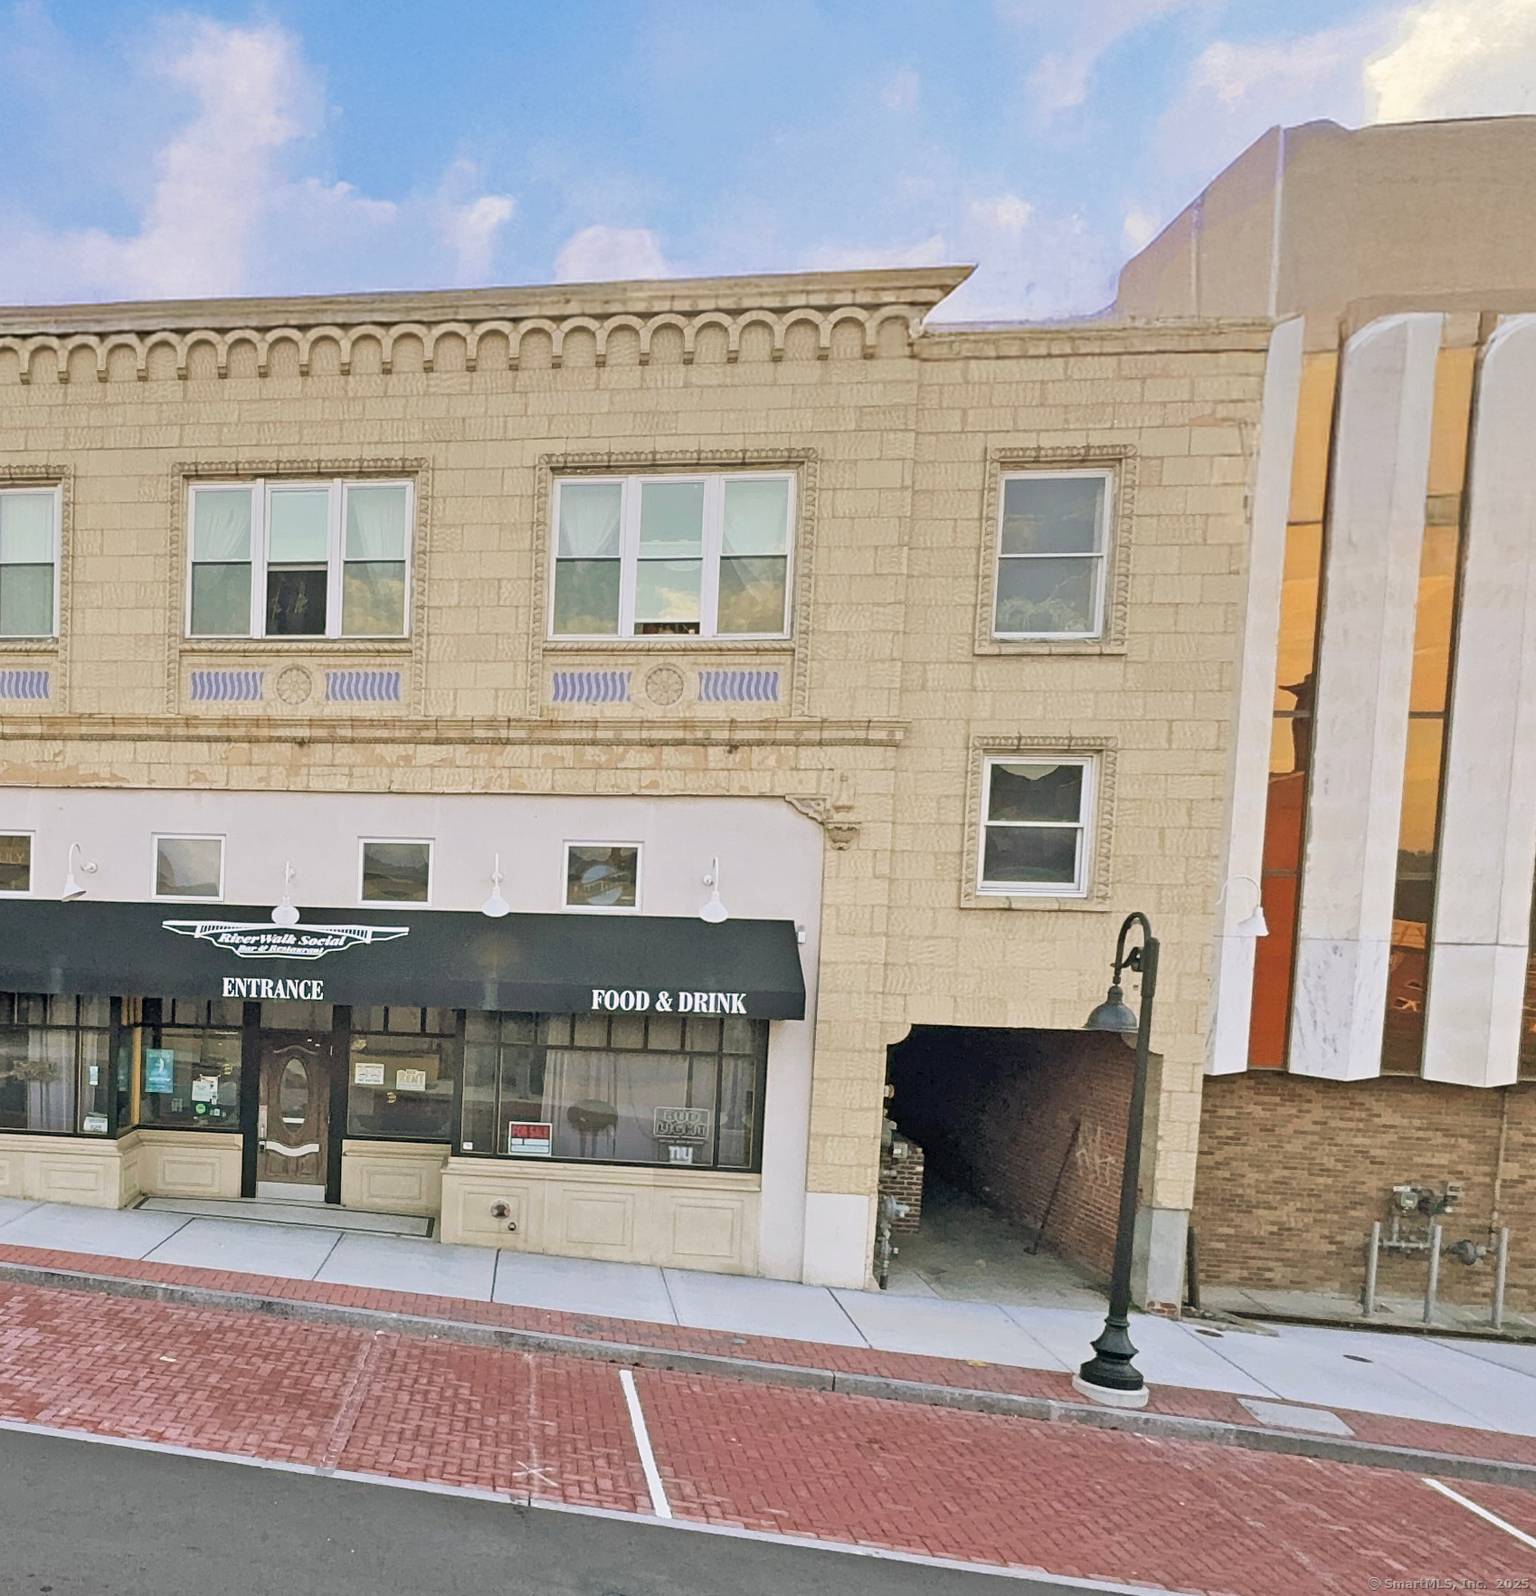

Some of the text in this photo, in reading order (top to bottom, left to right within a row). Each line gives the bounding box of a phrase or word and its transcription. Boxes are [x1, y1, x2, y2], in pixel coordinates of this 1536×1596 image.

[298, 935, 347, 946] Social
[222, 977, 325, 1000] ENTRANCE
[591, 989, 748, 1015] FOOD & DRINK
